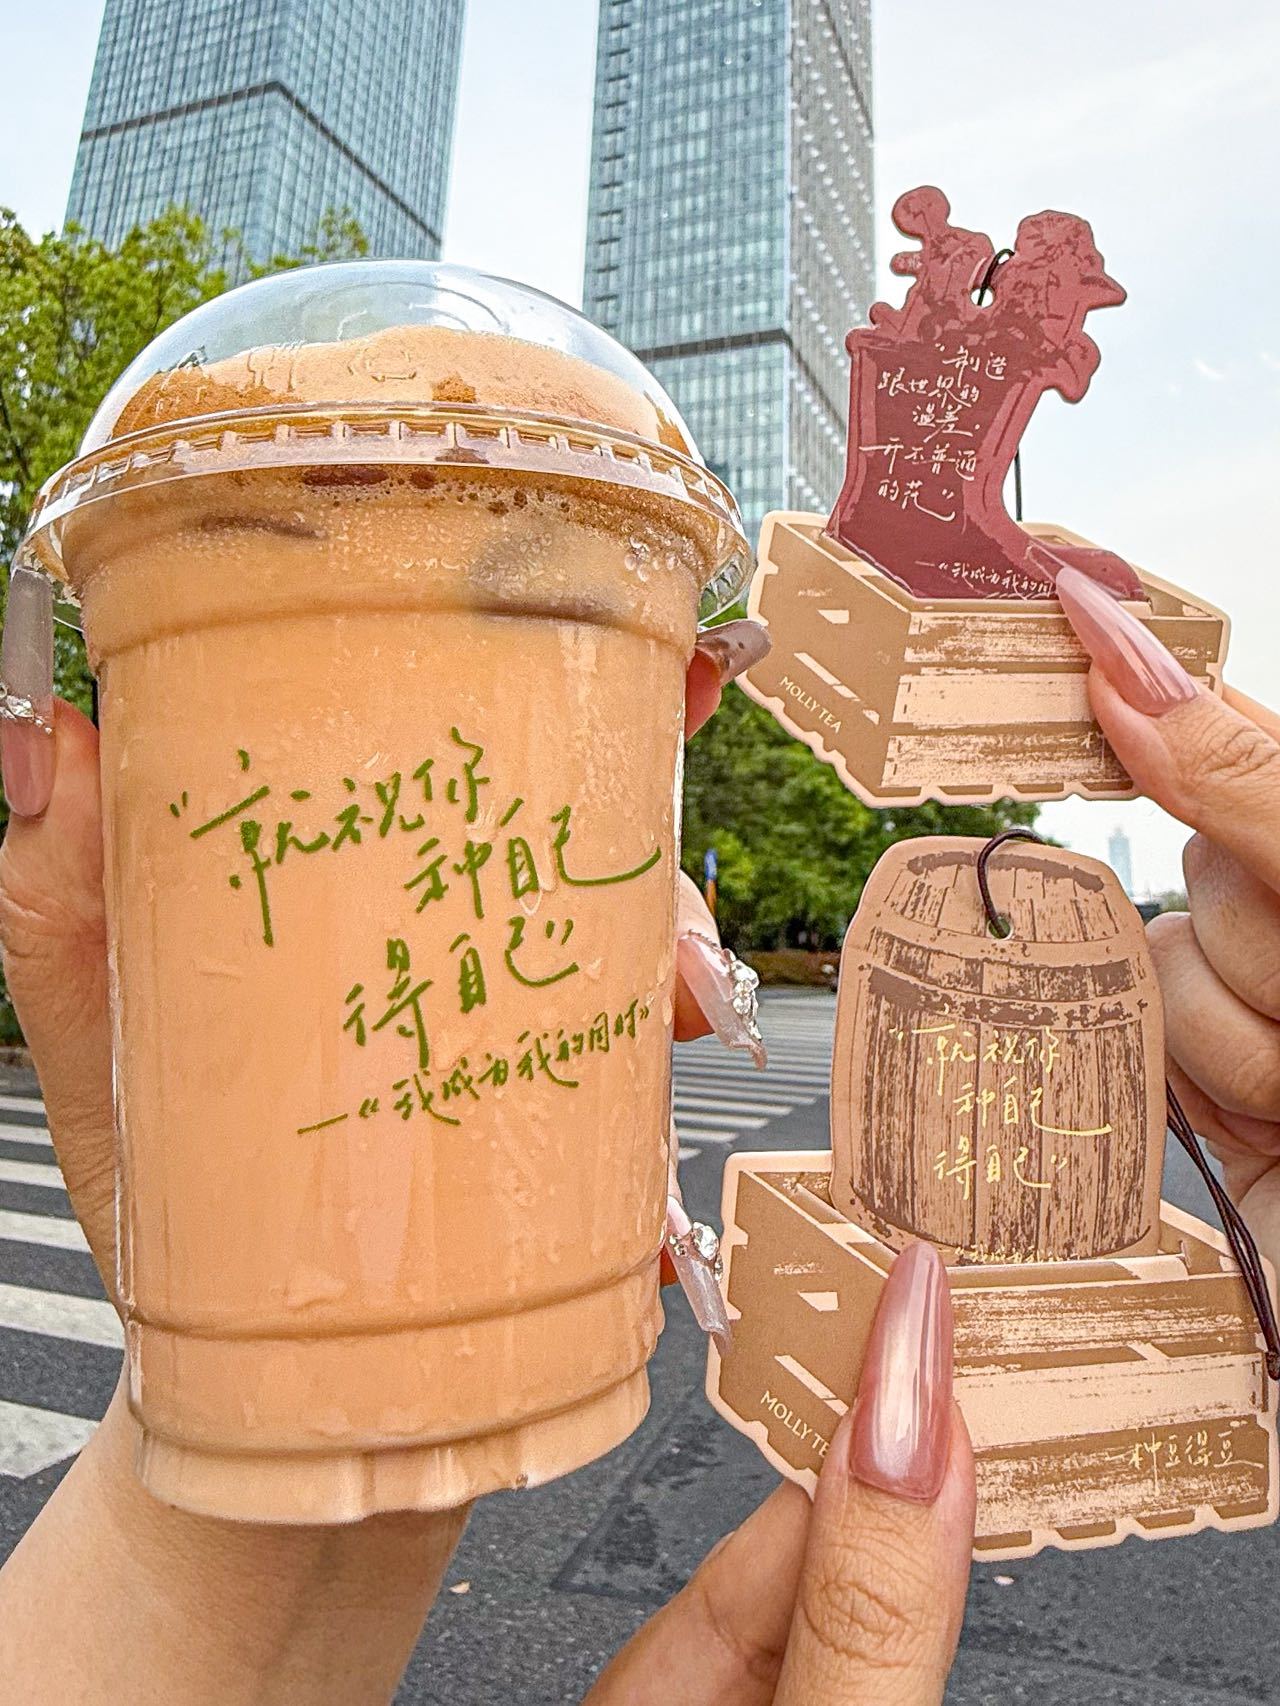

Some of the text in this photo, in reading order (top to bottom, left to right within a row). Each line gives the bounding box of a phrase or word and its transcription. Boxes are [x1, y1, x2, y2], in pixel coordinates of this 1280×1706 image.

[779, 676, 843, 735] MOLLY TEA
[404, 797, 662, 919] 种自己
[953, 1075, 1113, 1137] 种自己
[760, 1389, 831, 1458] MOLLY TE
